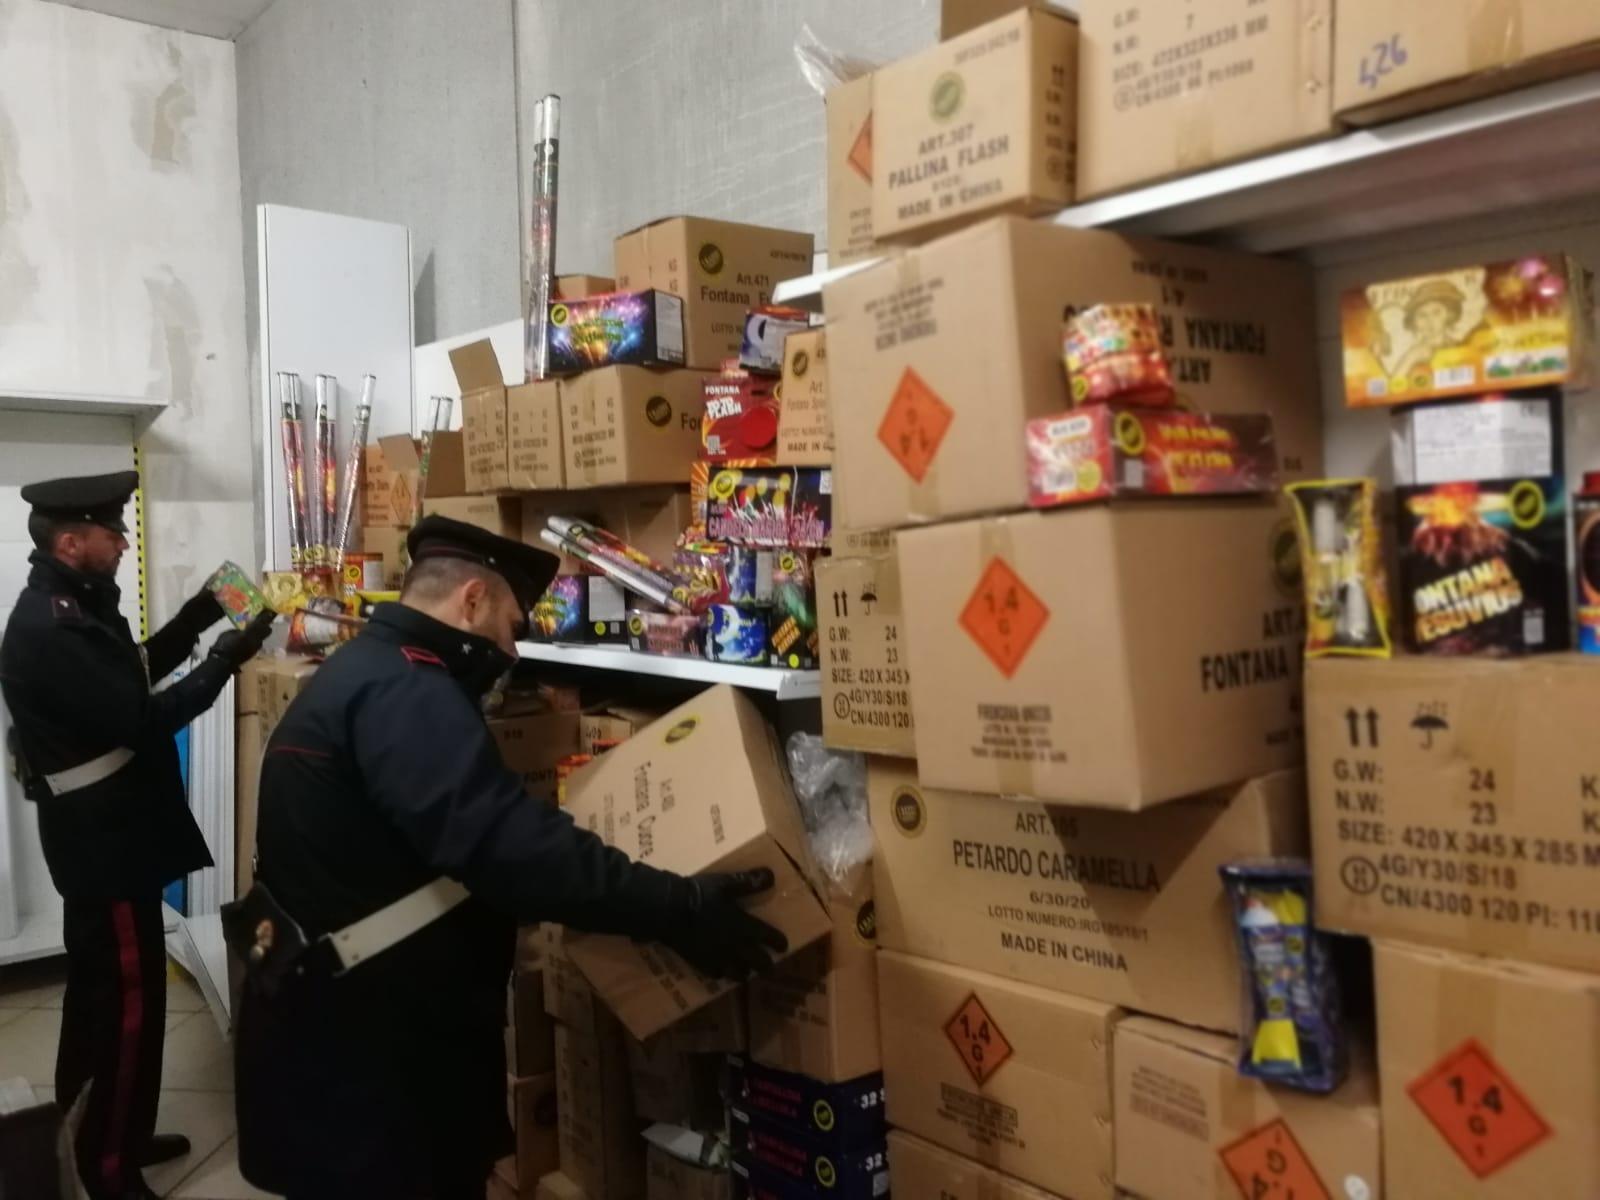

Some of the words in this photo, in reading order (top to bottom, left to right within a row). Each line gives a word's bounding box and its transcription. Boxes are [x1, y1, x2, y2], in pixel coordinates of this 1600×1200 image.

[888, 155, 949, 189] PALLINA
[957, 134, 1010, 168] FLASH
[897, 198, 932, 220] MADE
[938, 193, 954, 209] IN
[959, 177, 1003, 203] CHINA
[700, 286, 750, 305] Fontana
[1185, 318, 1267, 356] FONTANA
[829, 625, 851, 643] G.W:
[885, 624, 897, 641] 24
[830, 648, 851, 664] N.W:
[886, 648, 898, 664] 23
[831, 667, 856, 684] SIZE:
[859, 669, 875, 685] 420
[876, 670, 883, 685] X
[885, 670, 903, 685] 345
[1201, 650, 1289, 692] FONTANA
[891, 710, 910, 729] 120
[1333, 758, 1383, 784] G.W:
[1469, 768, 1496, 793] 24
[1580, 776, 1600, 800] K
[1334, 790, 1384, 815] N.W:
[1469, 801, 1496, 826] 23
[1582, 811, 1600, 834] K
[1337, 818, 1392, 845] SIZE:
[1402, 827, 1440, 851] 420
[1443, 831, 1459, 852] X
[1465, 833, 1505, 858] 345
[1511, 837, 1528, 860] X
[1534, 839, 1578, 865] 285
[953, 839, 1033, 877] PETARDO
[1036, 850, 1162, 894] CARAMELLA
[1379, 853, 1518, 891] 4G/Y30/S/18
[988, 904, 1024, 921] LOTTO
[1380, 883, 1473, 917] CN/4300
[1480, 898, 1521, 924] 120
[1526, 902, 1559, 928] PI:
[1000, 931, 1047, 956] MADE
[1051, 941, 1068, 961] IN
[1072, 945, 1128, 973] CHINA
[960, 1014, 991, 1046] 1.4
[1447, 1074, 1504, 1115] 1.4
